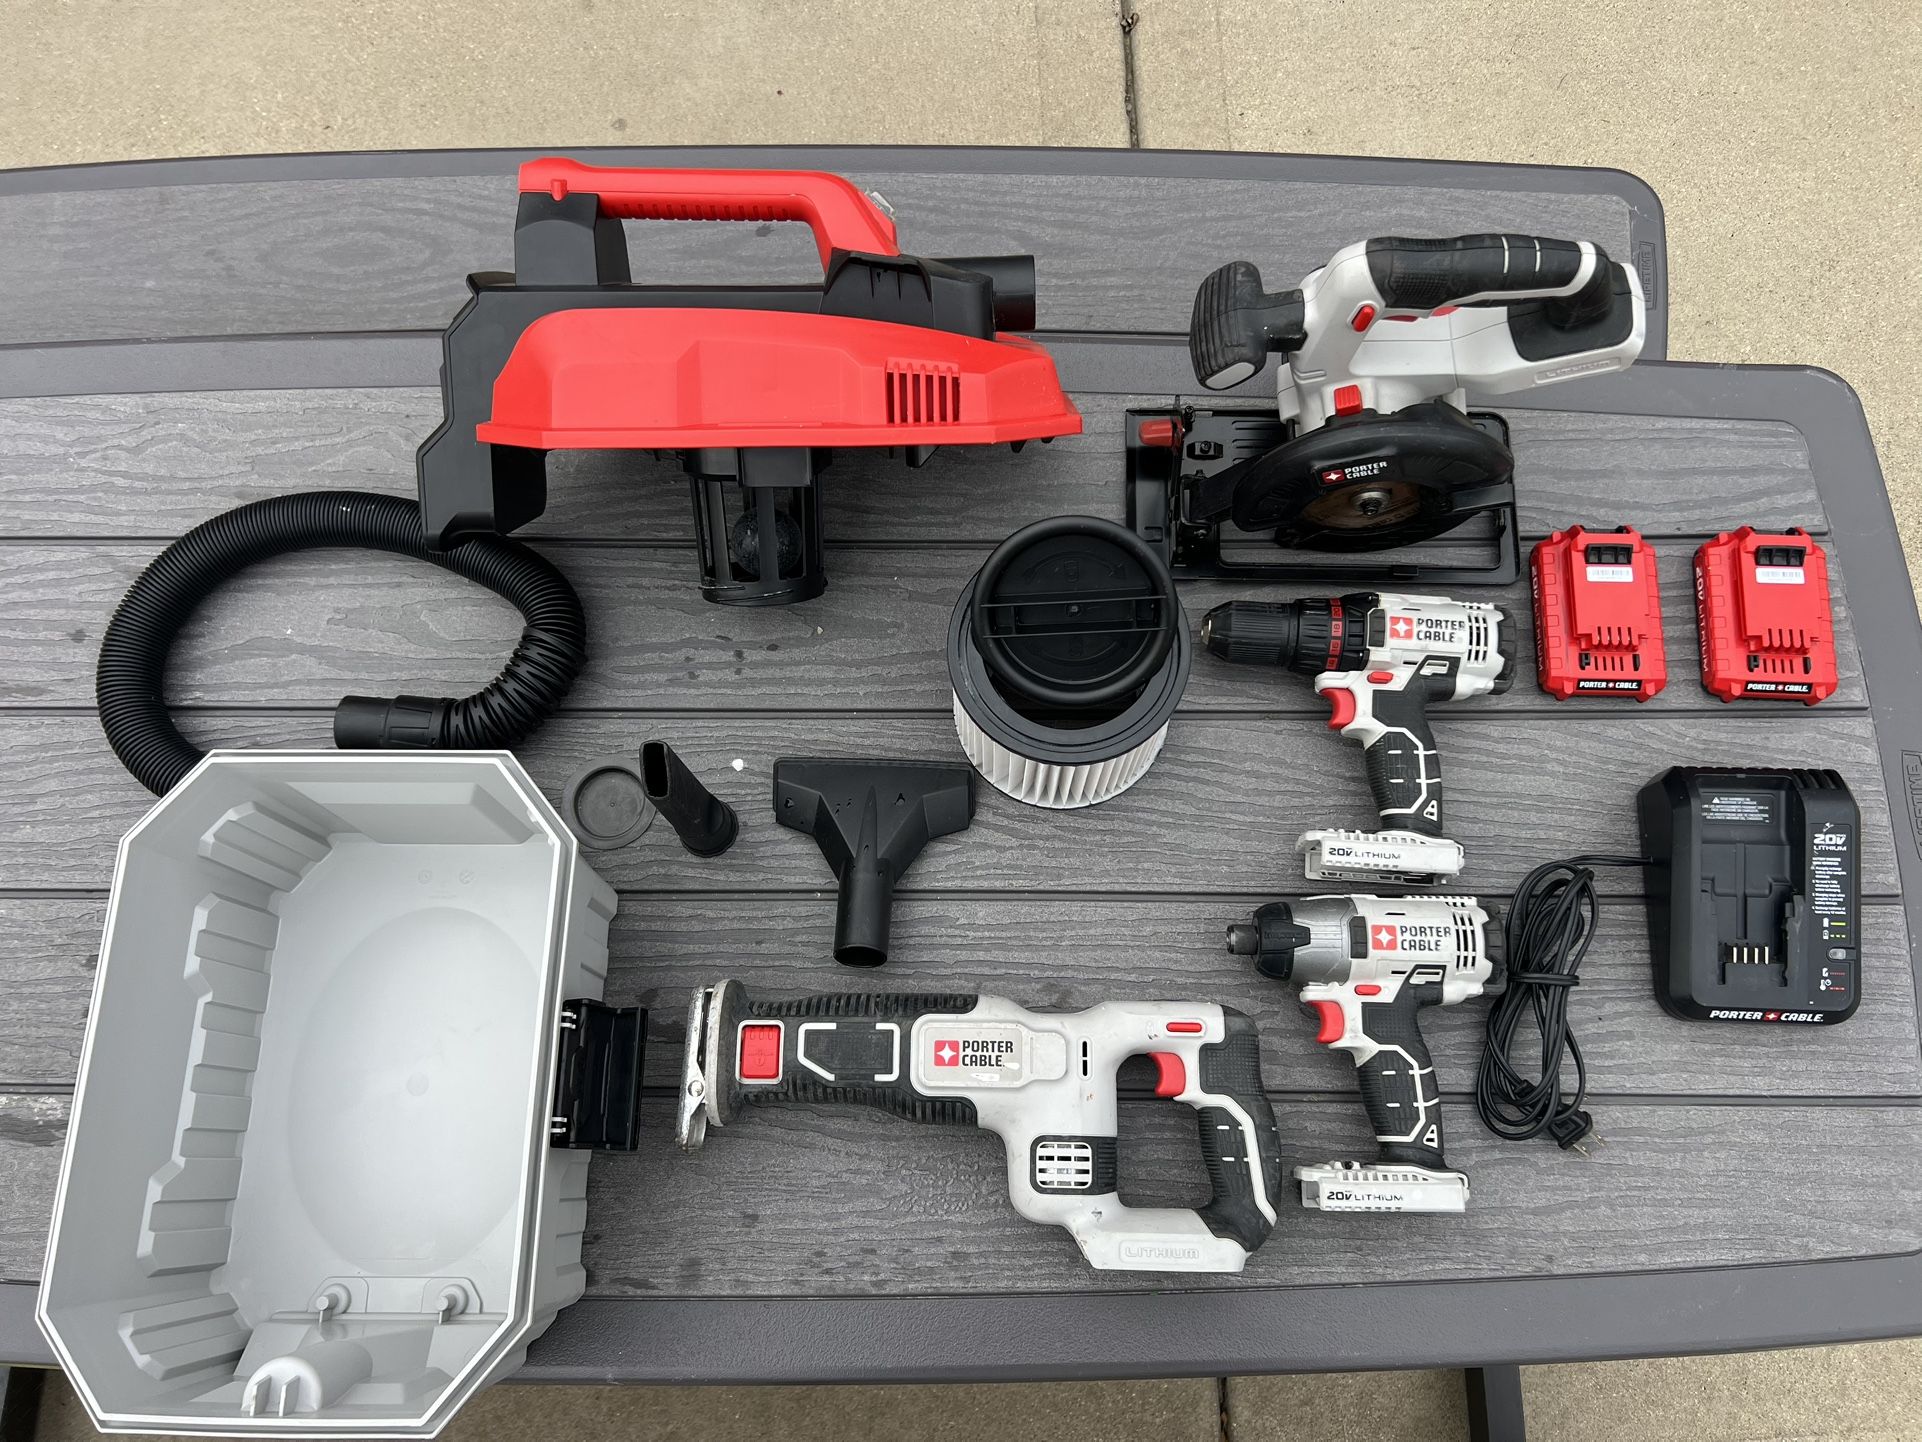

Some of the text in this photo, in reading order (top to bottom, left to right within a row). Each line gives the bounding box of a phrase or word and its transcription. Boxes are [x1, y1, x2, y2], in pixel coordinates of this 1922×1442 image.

[1344, 461, 1387, 474] PORTER
[1346, 468, 1380, 479] CABLE
[1416, 617, 1466, 630] PORTER
[1416, 630, 1456, 643] CABLE
[1534, 602, 1544, 671] LITHIUM
[1698, 604, 1709, 672] LITHIUM
[1747, 683, 1776, 691] PORTER
[1354, 851, 1400, 860] LITHIUM
[1401, 925, 1451, 937] PORTER
[1401, 939, 1441, 951] CABLE
[1709, 1010, 1763, 1020] PORTER
[962, 1040, 1014, 1053] PORTER
[1354, 1193, 1404, 1201] LITHIUM
[1125, 1246, 1200, 1259] LITHIUM
